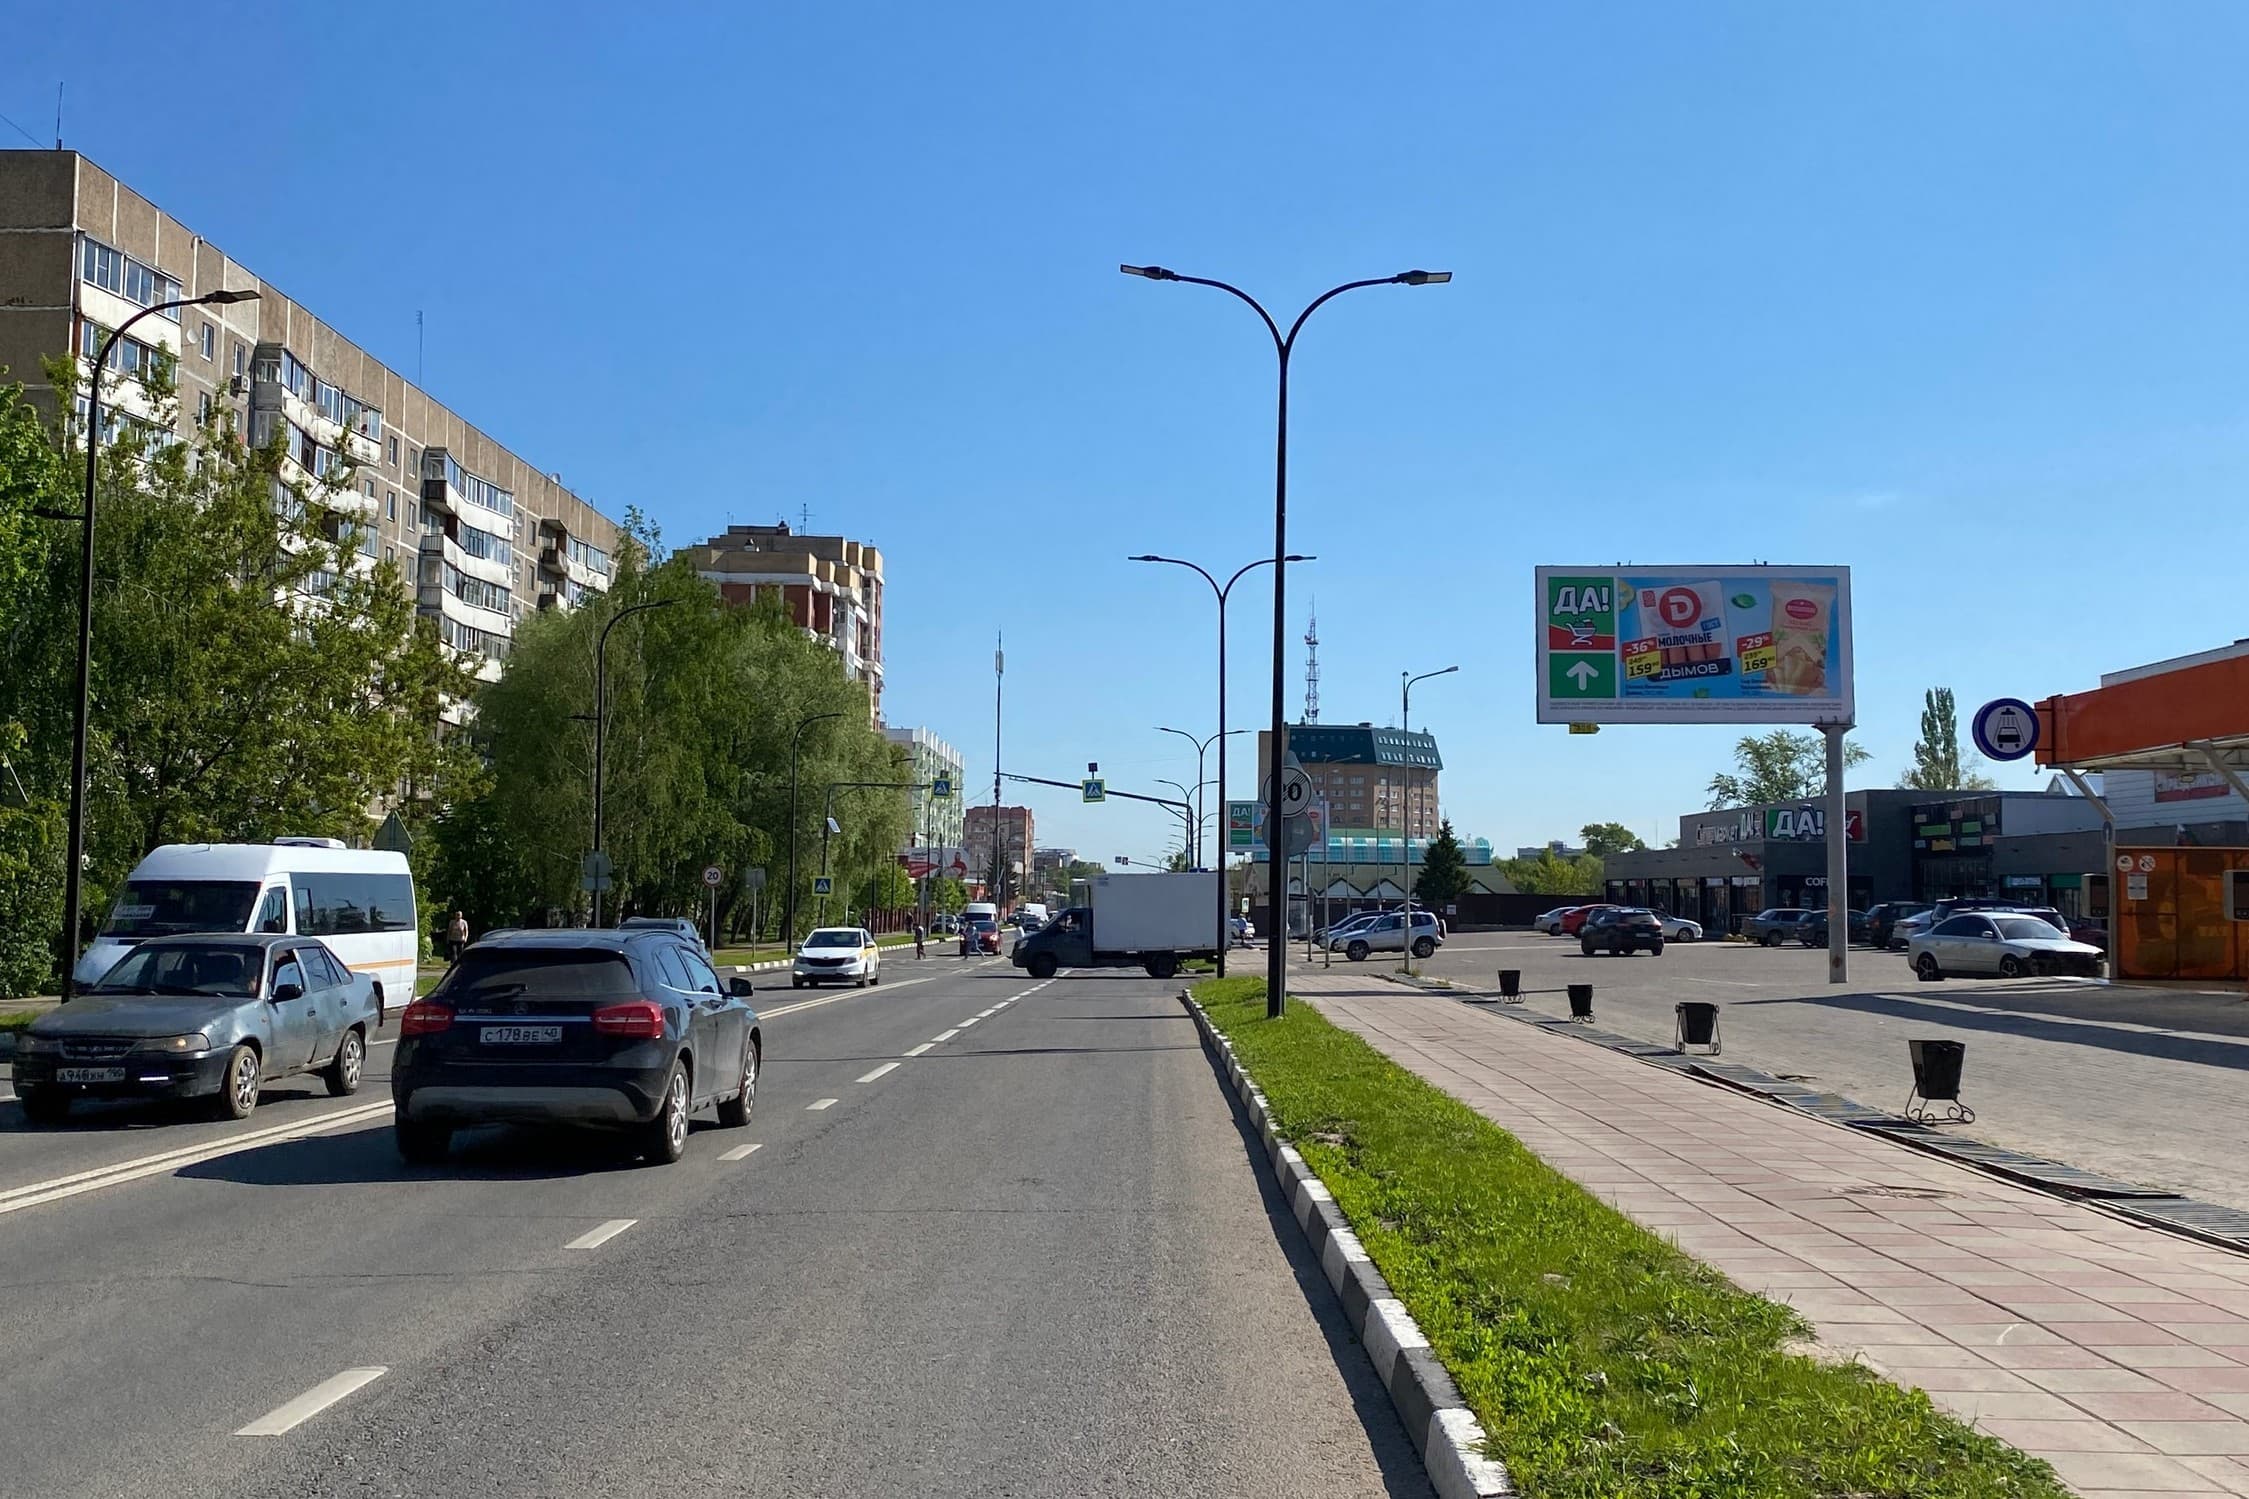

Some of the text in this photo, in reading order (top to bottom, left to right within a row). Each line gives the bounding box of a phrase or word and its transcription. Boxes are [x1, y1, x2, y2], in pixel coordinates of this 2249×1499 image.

[1553, 586, 1610, 615] ДА!
[1668, 595, 1695, 621] D
[1658, 632, 1713, 648] МОЛОЧНЫЕ
[1660, 663, 1720, 679] ДЫМОВ
[1773, 811, 1824, 838] ДА!
[707, 871, 719, 881] 20
[1804, 877, 1829, 887] COF
